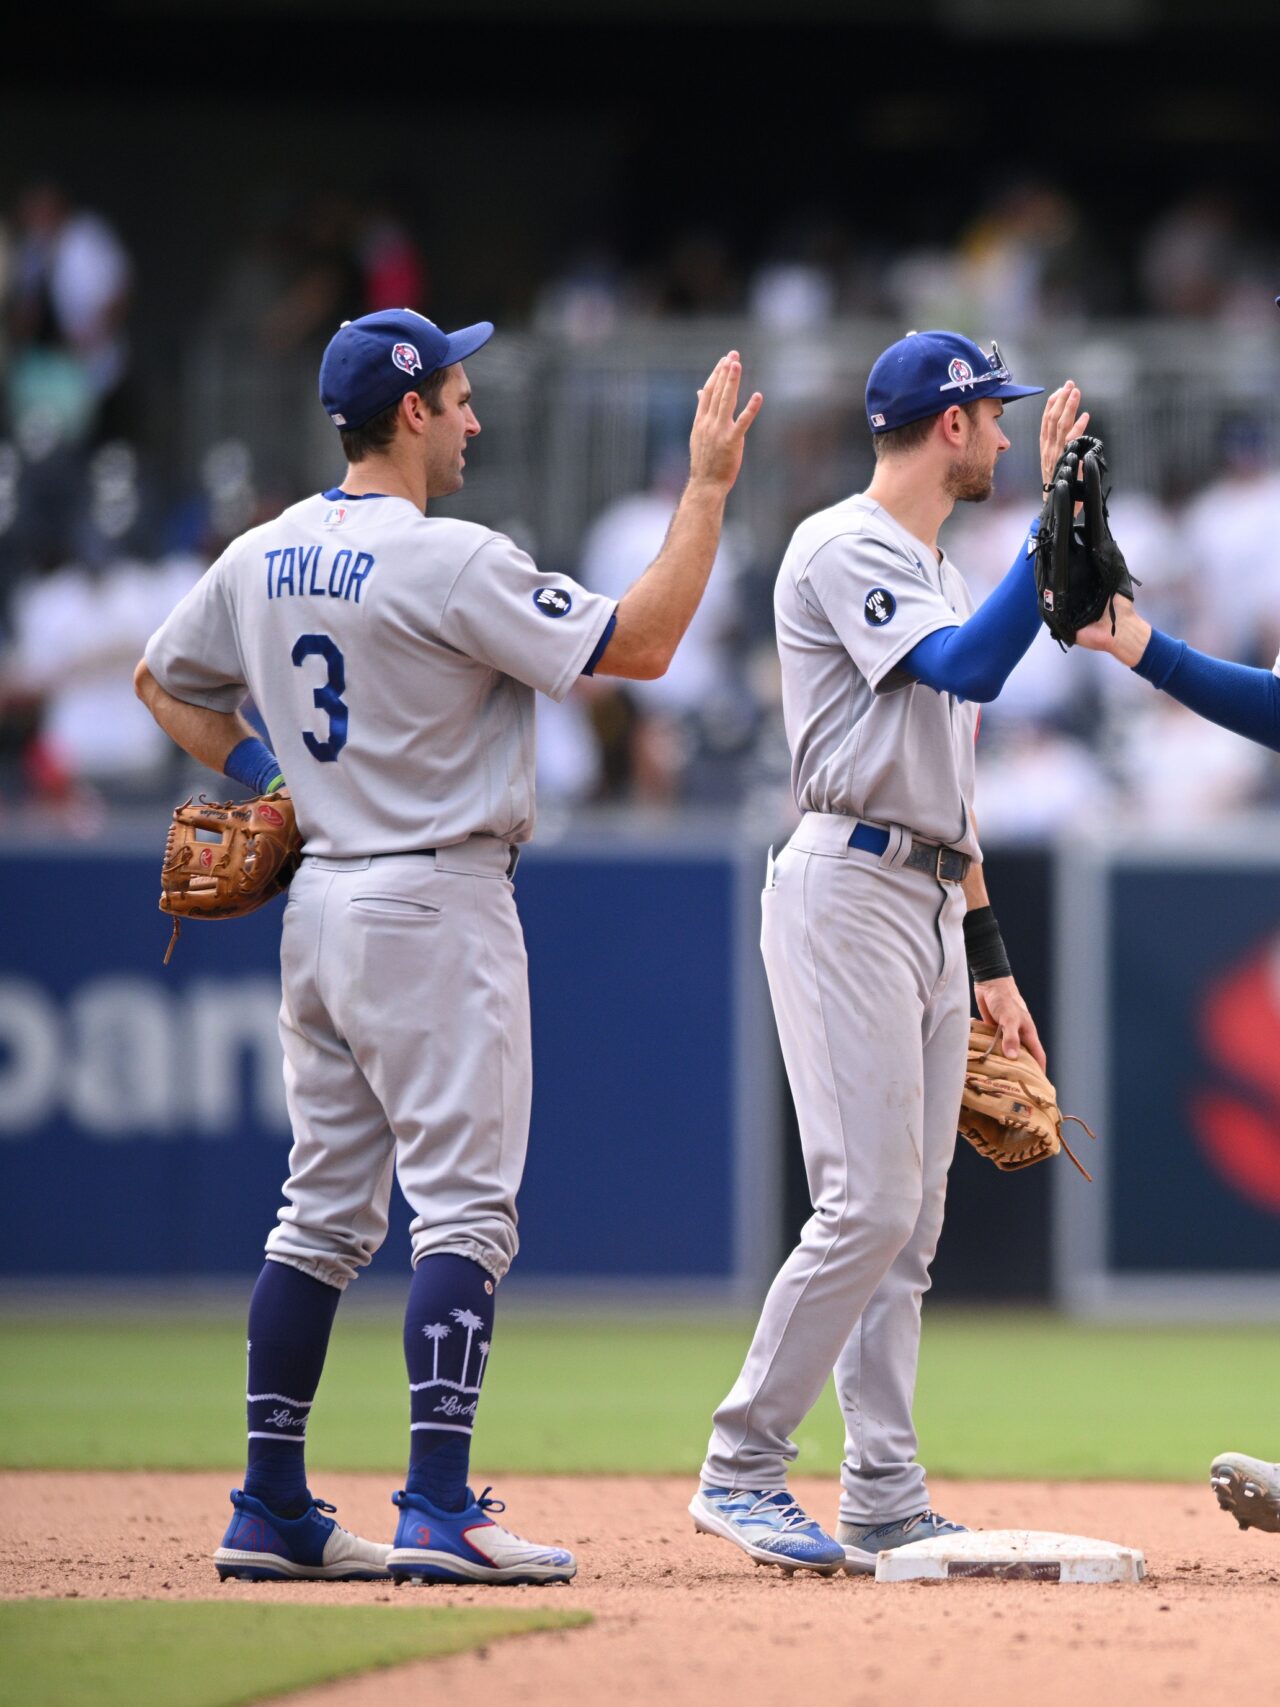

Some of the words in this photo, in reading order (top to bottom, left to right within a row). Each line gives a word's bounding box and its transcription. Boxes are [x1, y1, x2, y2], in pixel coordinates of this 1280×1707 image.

[264, 546, 375, 603] TAYLOR
[537, 589, 557, 605] VIN
[866, 591, 885, 610] VIN
[291, 634, 349, 763] 3
[433, 1395, 462, 1417] Los
[264, 1409, 294, 1428] Los
[416, 1526, 431, 1546] 3
